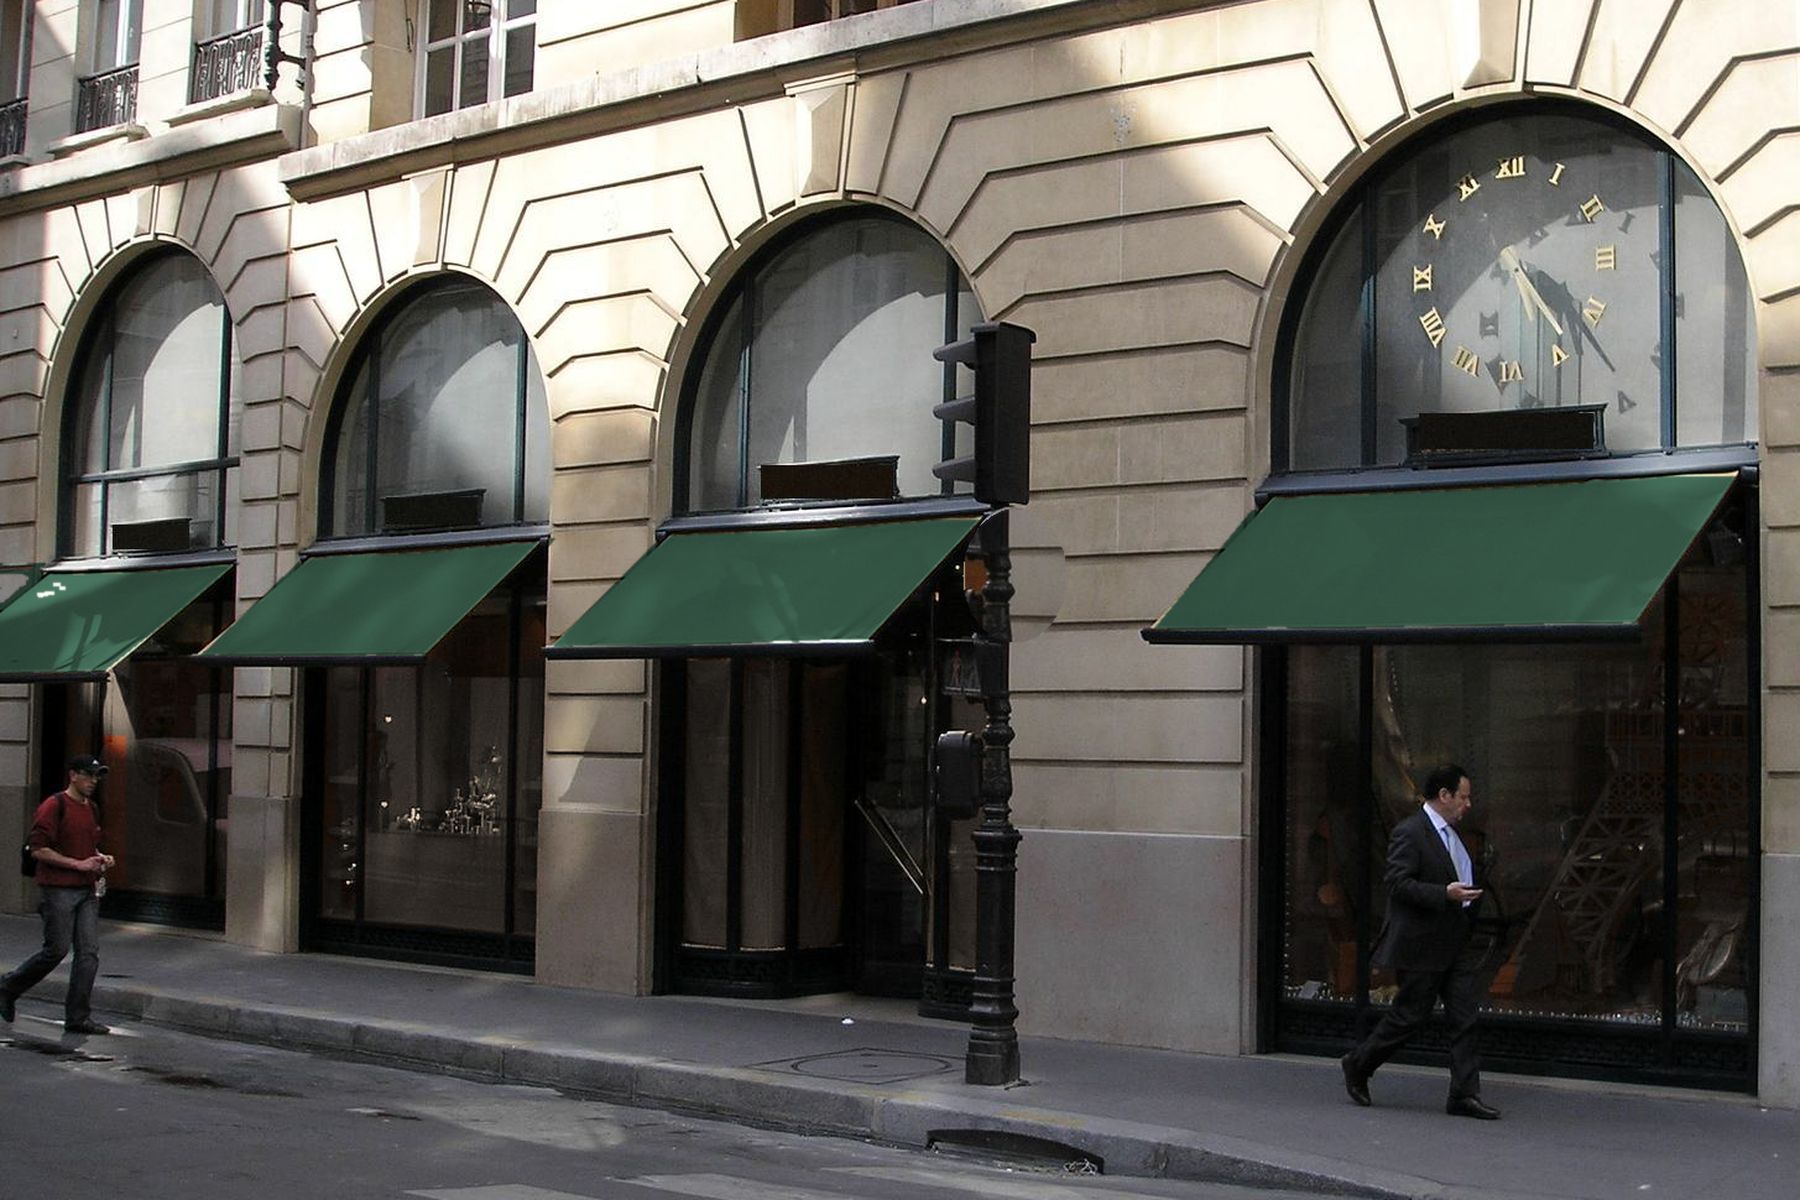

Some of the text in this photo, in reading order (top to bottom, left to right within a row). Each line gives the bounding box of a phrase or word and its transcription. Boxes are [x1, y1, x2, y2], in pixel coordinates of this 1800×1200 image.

[1422, 213, 1447, 240] X
[1595, 243, 1616, 272] III
[1412, 263, 1432, 293] IX
